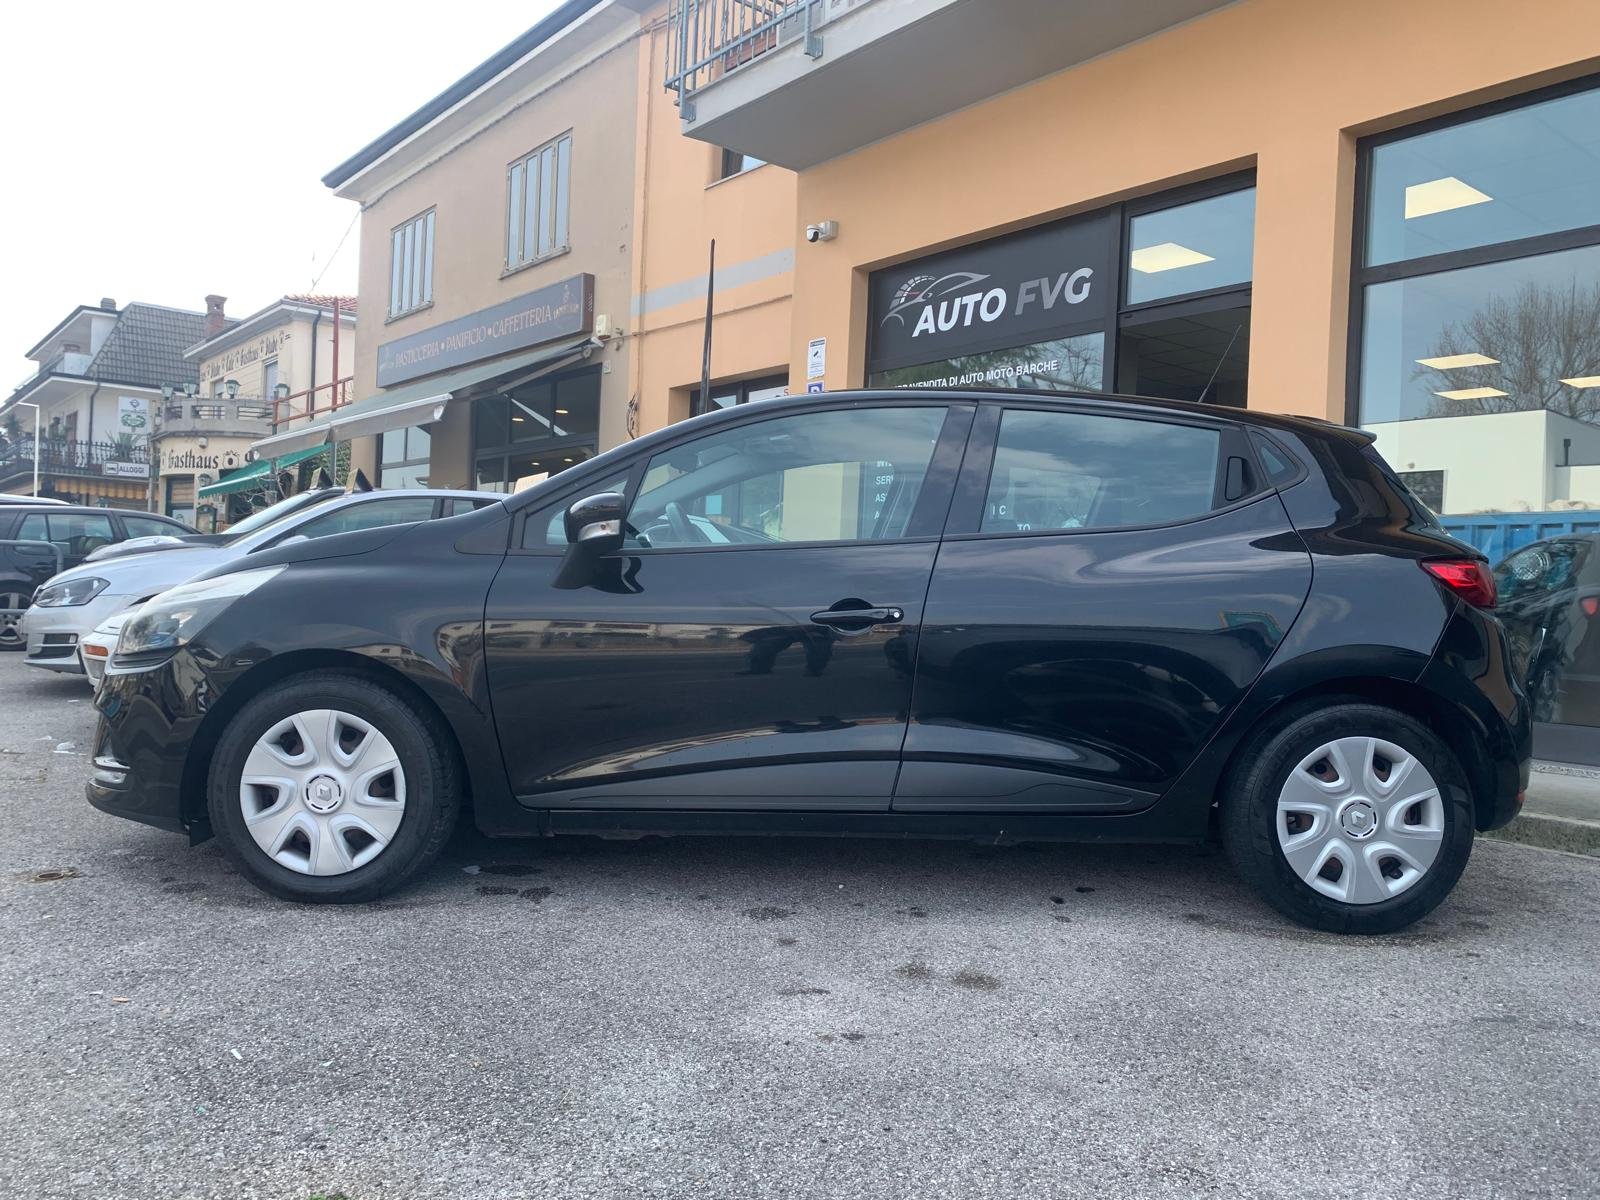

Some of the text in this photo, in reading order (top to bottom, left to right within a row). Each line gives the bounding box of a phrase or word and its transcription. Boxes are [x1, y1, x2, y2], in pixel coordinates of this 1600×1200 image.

[911, 267, 1094, 338] AUTO FVG
[395, 341, 440, 368] PASTICCERIA
[445, 327, 487, 352] PANIFICIO
[492, 304, 552, 338] CAFFETTERIA
[949, 376, 958, 387] DI
[960, 372, 984, 385] AUTO
[986, 367, 1014, 381] MOTO
[1015, 360, 1058, 376] BARCHE
[119, 465, 146, 475] ALLOGGI
[168, 449, 219, 469] Gasthaus
